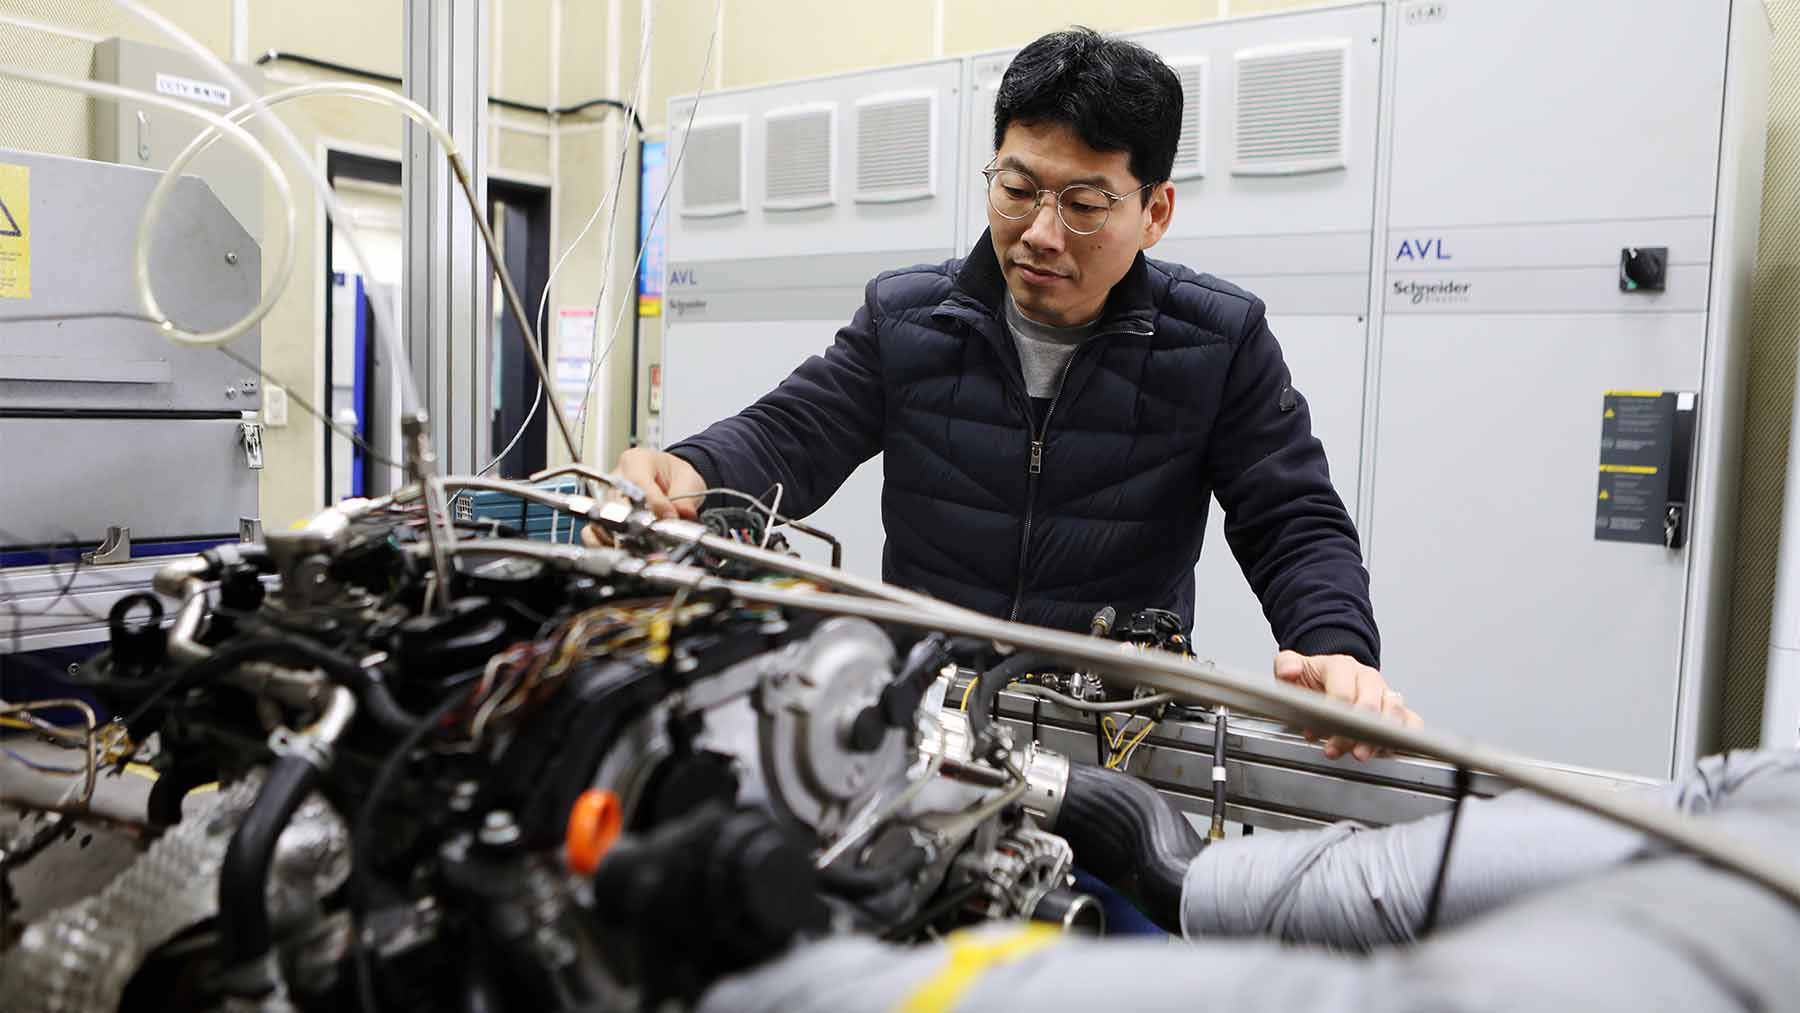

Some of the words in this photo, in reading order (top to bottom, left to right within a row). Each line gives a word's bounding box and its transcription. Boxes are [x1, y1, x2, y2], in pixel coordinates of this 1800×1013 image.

[1396, 238, 1452, 261] AVL
[670, 269, 697, 286] AVL
[1394, 280, 1471, 304] Schneider
